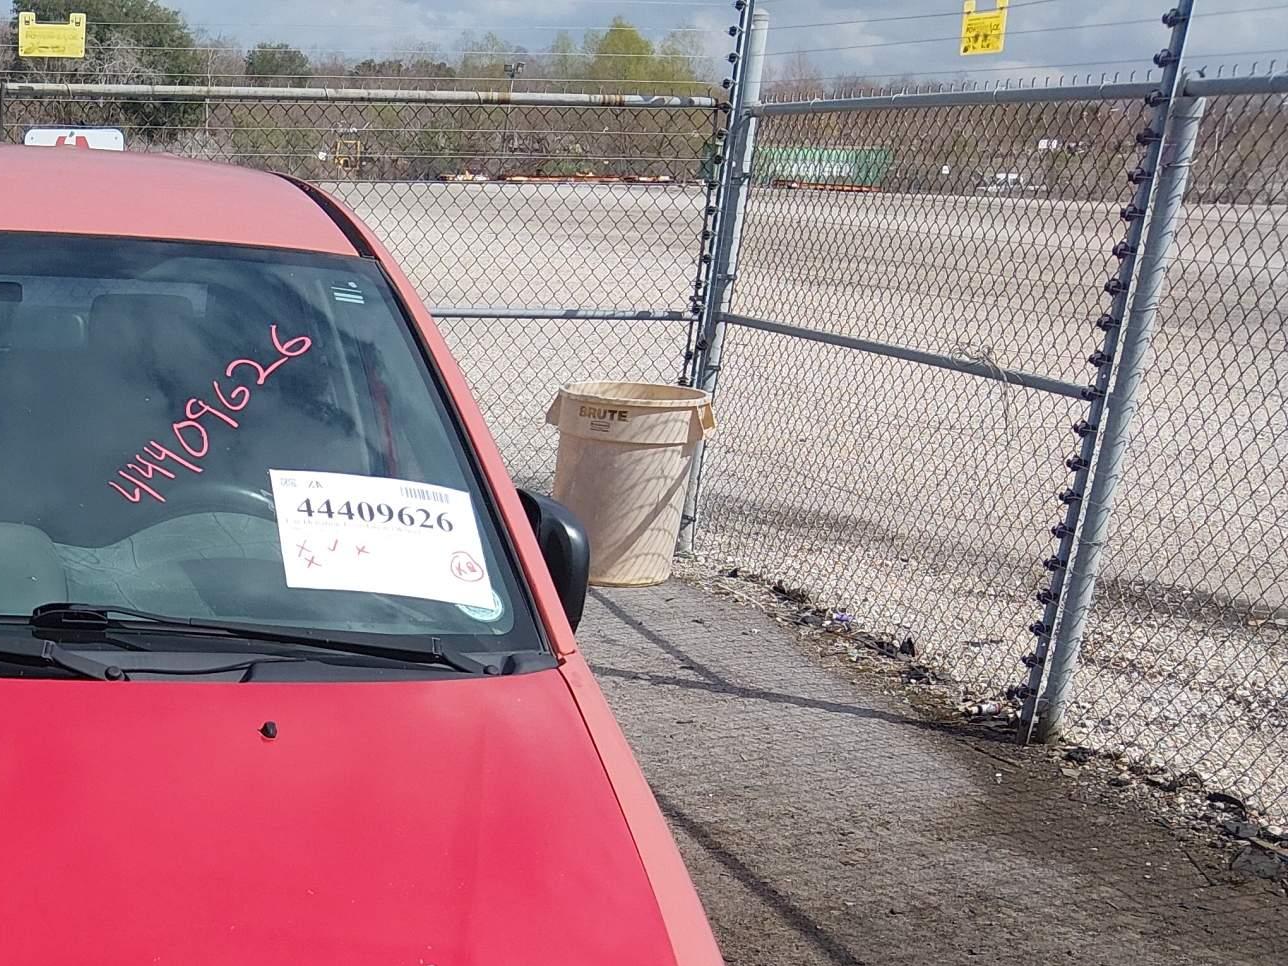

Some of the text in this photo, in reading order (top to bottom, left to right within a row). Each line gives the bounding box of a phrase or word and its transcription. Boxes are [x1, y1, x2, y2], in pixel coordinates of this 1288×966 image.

[108, 324, 312, 503] 44409626
[579, 405, 628, 422] BRUTE
[296, 497, 455, 533] 44409626
